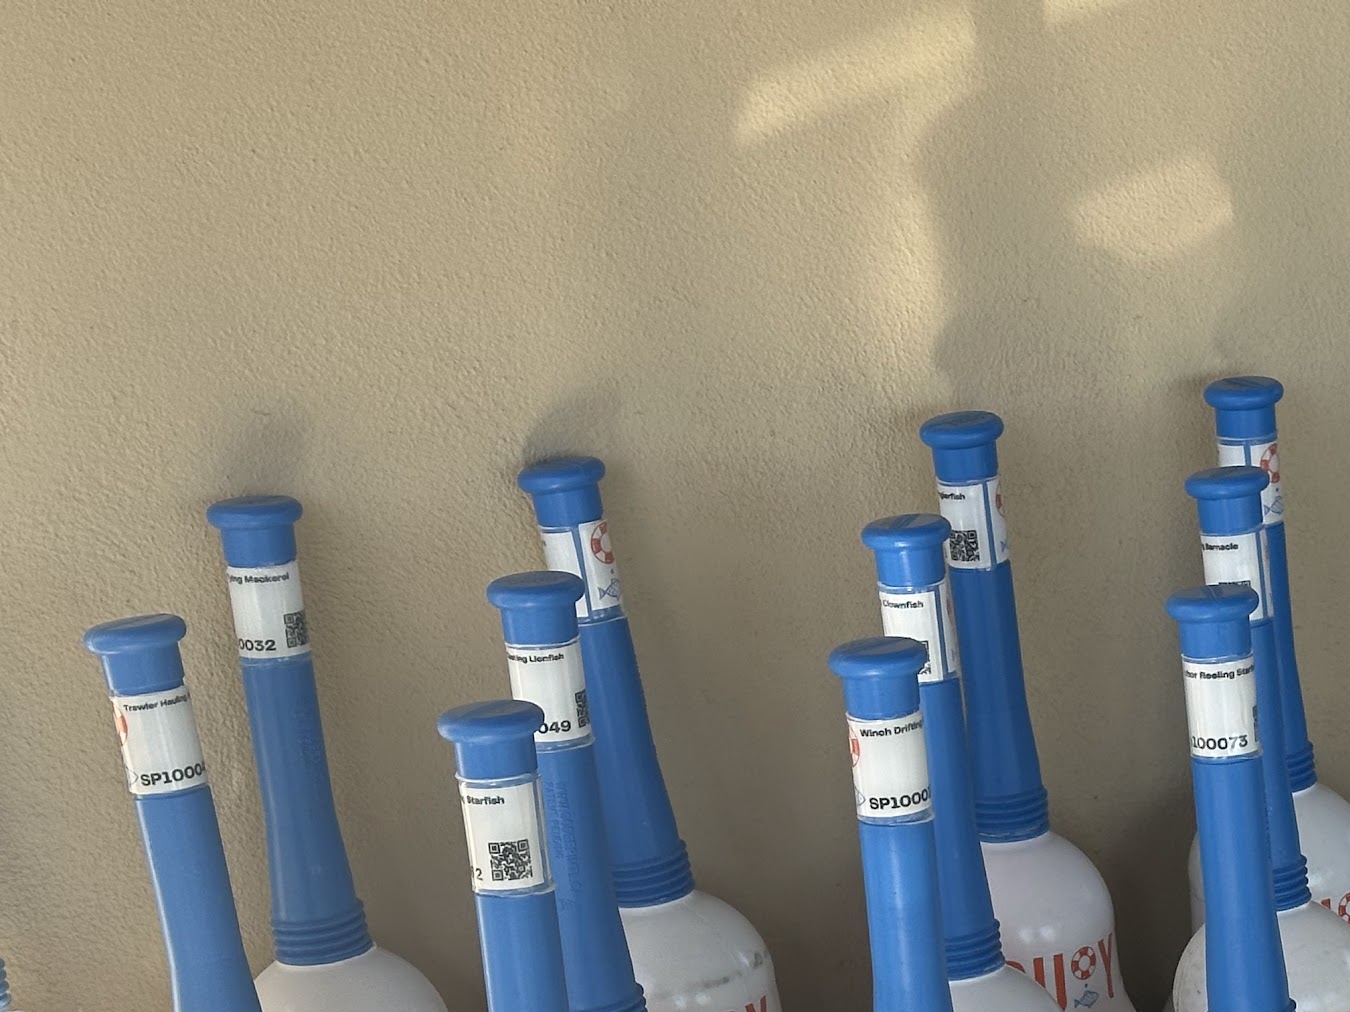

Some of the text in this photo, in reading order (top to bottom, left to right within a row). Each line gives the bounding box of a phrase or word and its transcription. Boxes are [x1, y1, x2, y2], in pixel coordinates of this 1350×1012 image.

[244, 571, 290, 583] Mackerel
[882, 599, 924, 609] Clownfish
[529, 652, 565, 663] Lionfish
[1199, 670, 1235, 680] Reeling
[123, 701, 159, 713] Trawler
[859, 727, 893, 738] Winch
[1191, 734, 1249, 751] 100073
[466, 795, 505, 805] Starfish
